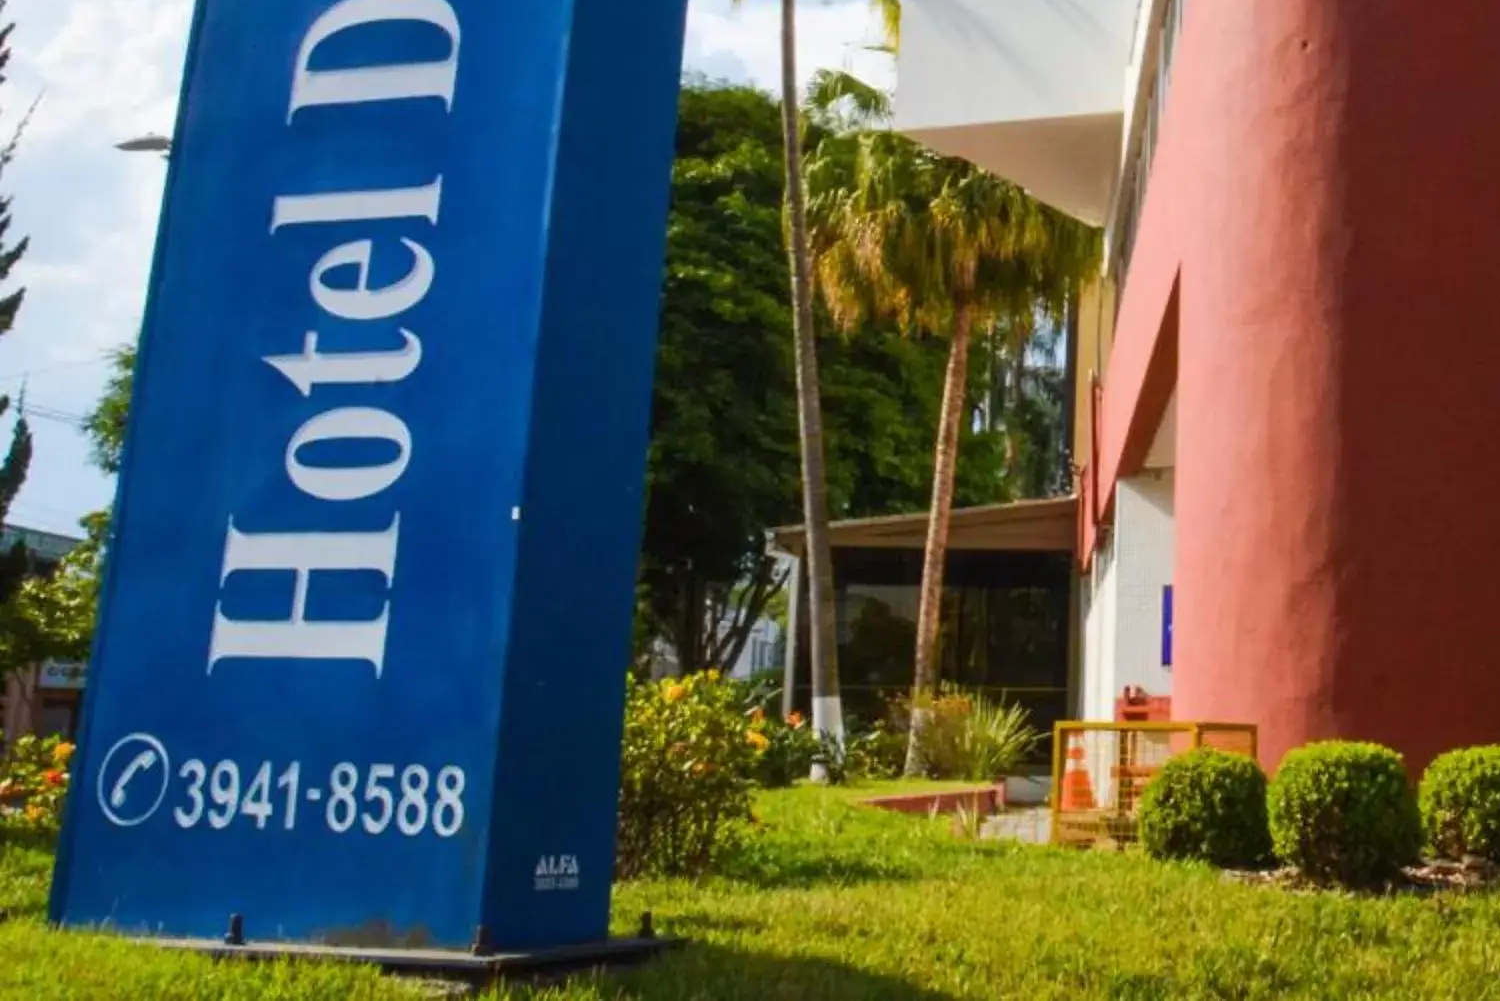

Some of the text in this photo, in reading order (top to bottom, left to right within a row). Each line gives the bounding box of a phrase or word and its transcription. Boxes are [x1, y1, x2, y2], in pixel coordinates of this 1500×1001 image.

[207, 174, 443, 681] Hotel
[173, 758, 467, 838] 3941-8588
[535, 854, 579, 875] ALFA
